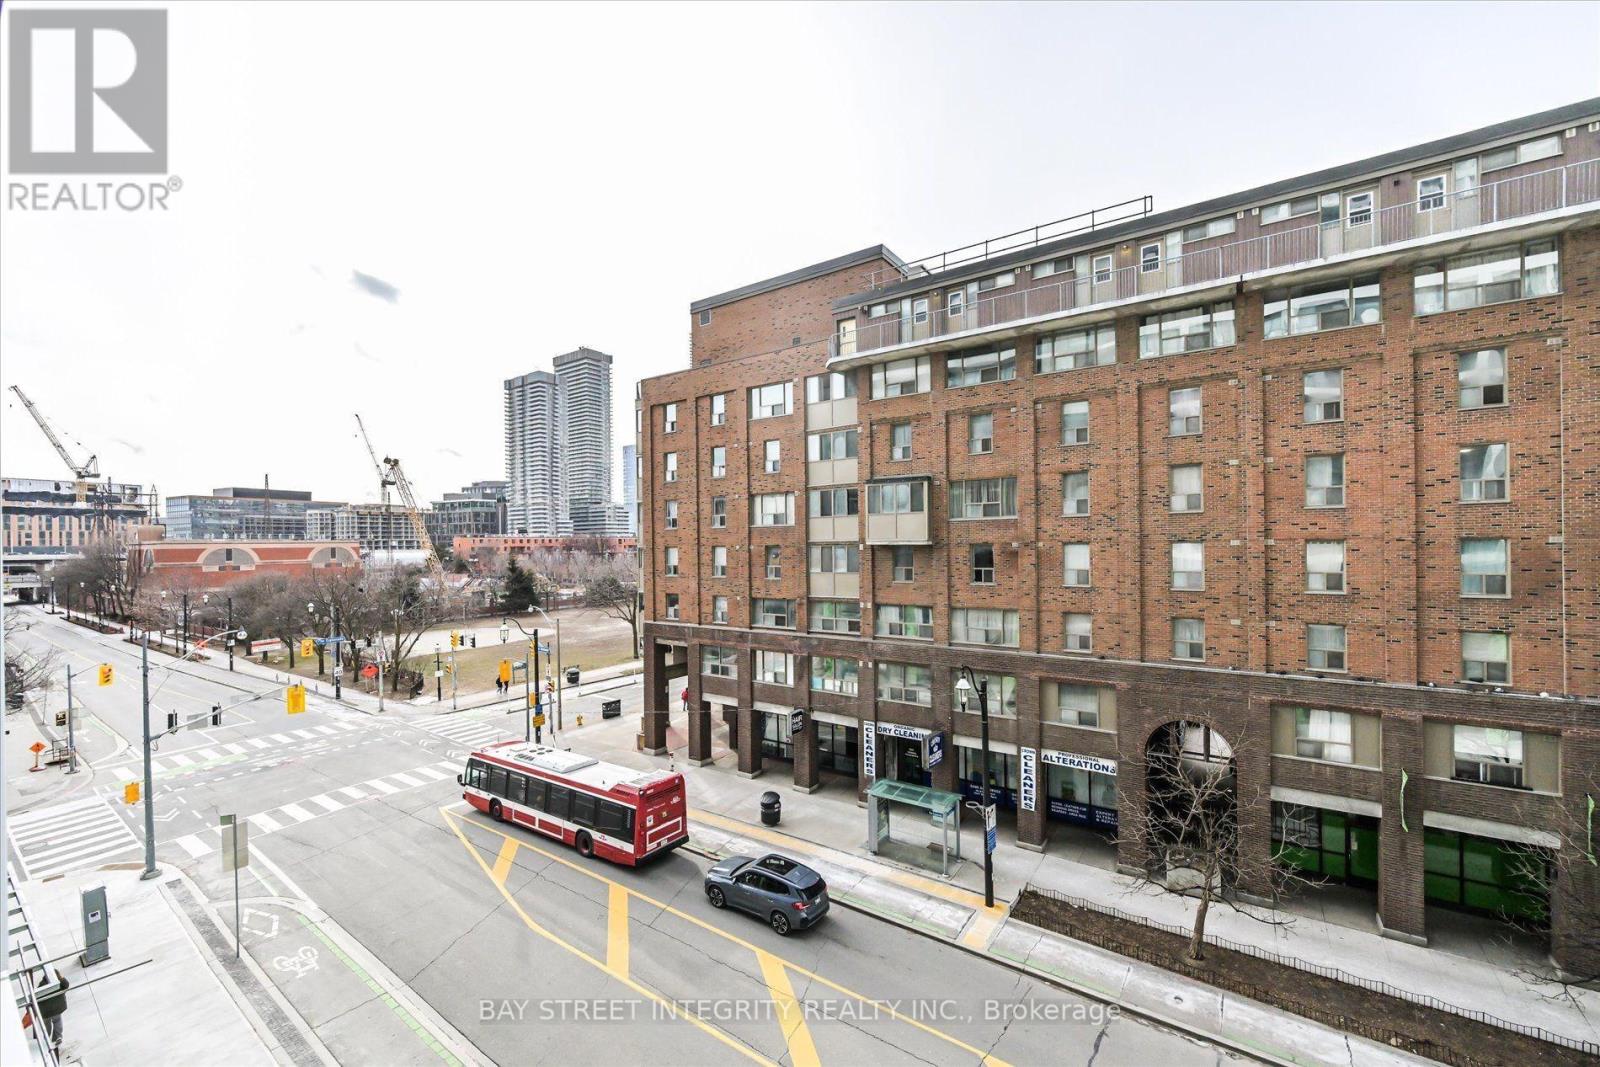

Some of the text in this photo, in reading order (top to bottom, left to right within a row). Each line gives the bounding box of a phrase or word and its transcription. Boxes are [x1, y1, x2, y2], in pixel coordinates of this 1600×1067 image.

[877, 726, 929, 740] DRY CLEANIN
[893, 724, 915, 732] ORGANIC
[864, 727, 874, 775] CLEANERS
[1058, 752, 1099, 762] PROFESSIONAL
[1023, 755, 1034, 809] CLEANERS
